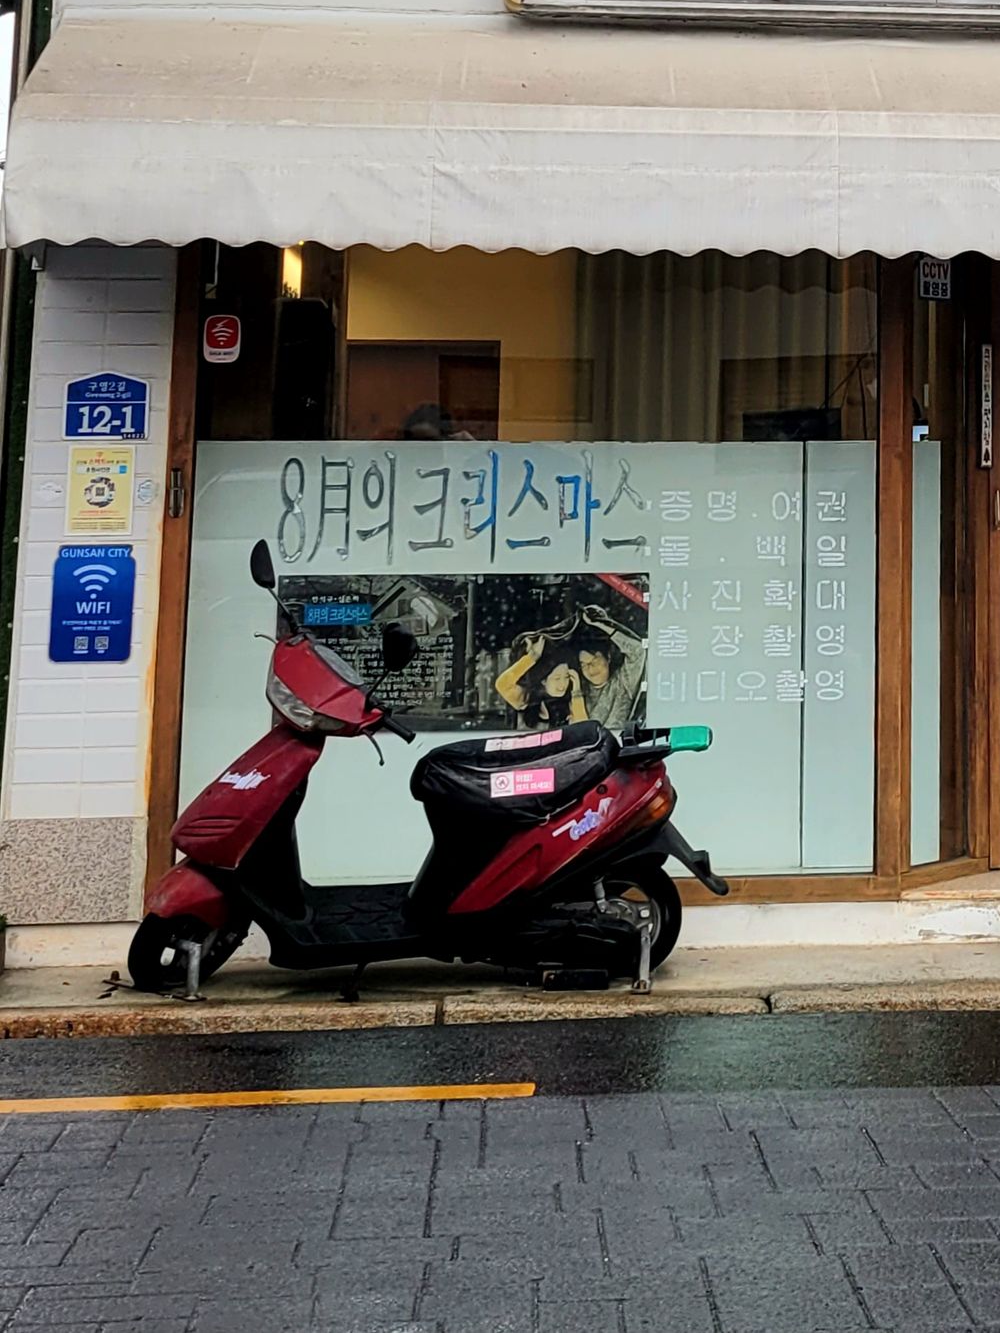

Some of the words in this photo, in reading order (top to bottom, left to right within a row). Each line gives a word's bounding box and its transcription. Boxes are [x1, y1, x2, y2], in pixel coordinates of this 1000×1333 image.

[922, 261, 950, 280] CCTV
[77, 405, 136, 434] 12-1
[407, 450, 648, 564] 크리스마스
[61, 548, 105, 558] GUNSAN
[108, 547, 130, 558] CITY
[76, 601, 111, 615] WIFI
